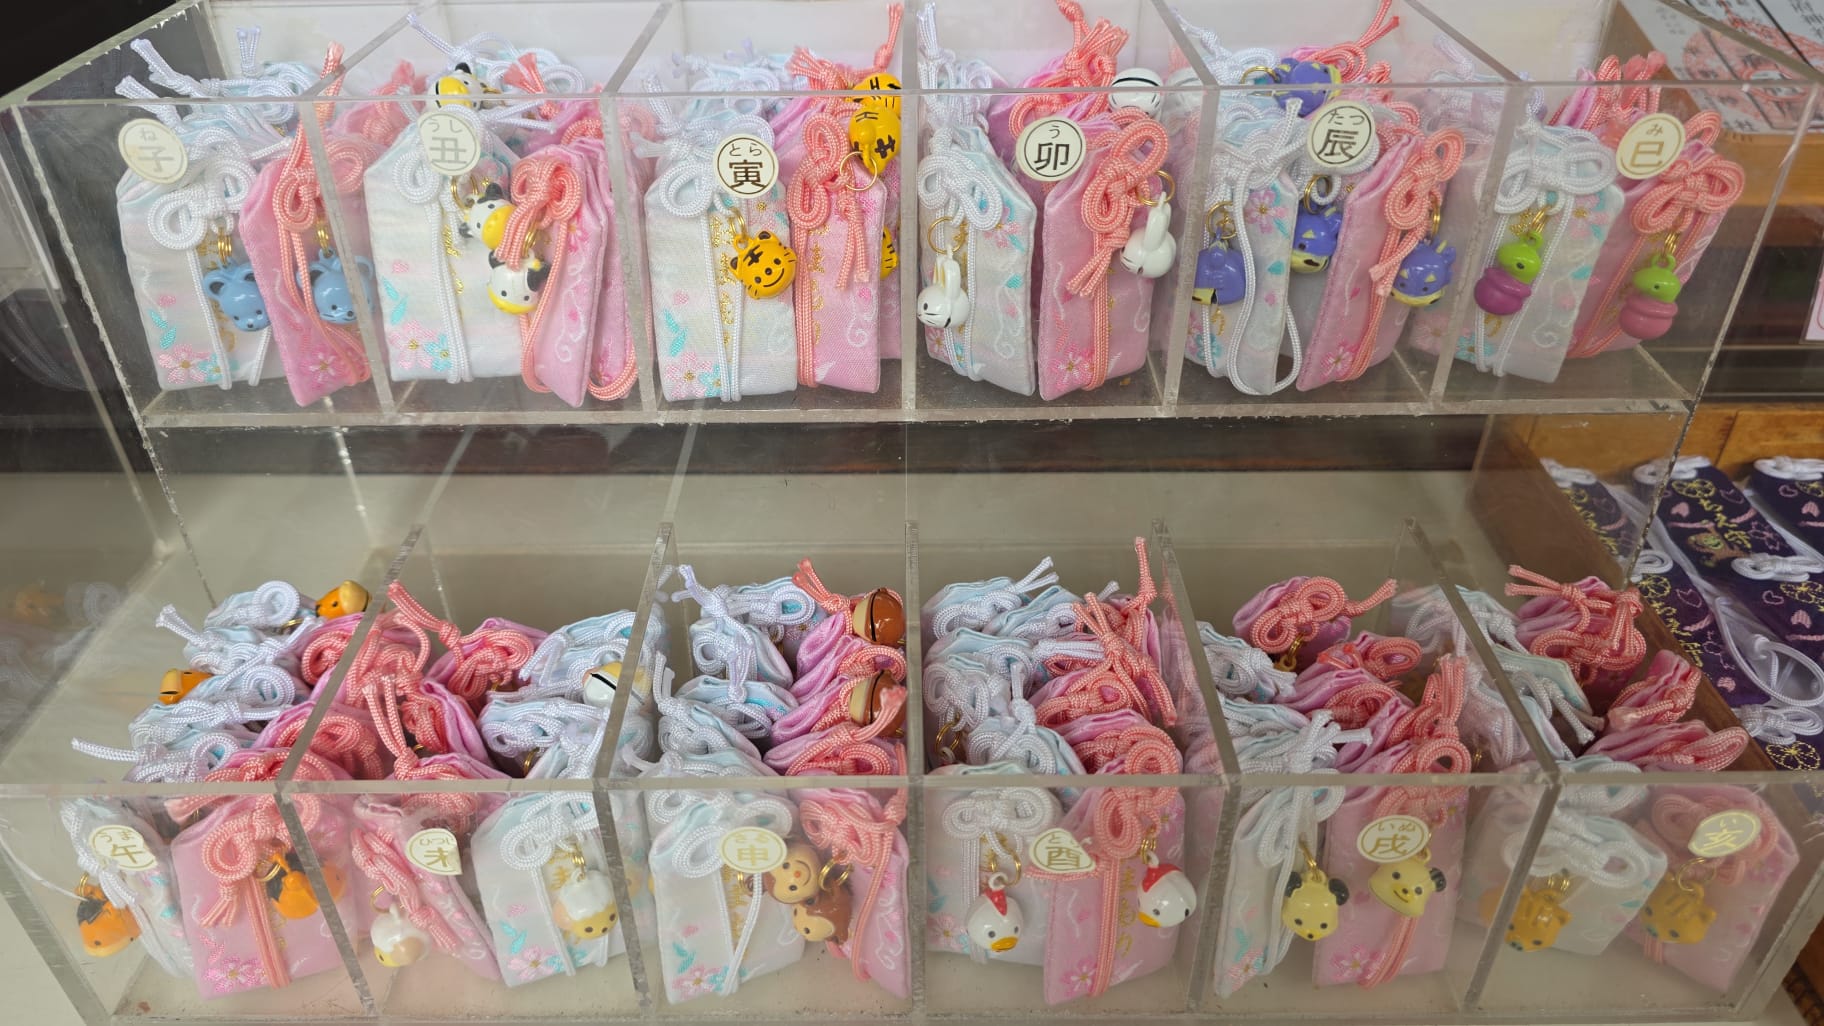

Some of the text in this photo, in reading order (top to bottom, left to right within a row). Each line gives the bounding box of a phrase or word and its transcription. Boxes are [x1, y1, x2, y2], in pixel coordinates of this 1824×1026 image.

[428, 118, 462, 133] うし
[1327, 109, 1365, 126] たつ
[140, 127, 158, 141] ね
[1048, 125, 1060, 138] う
[1646, 124, 1663, 136] み
[429, 136, 467, 165] 丑
[730, 143, 762, 157] とら
[1318, 129, 1360, 158] 辰
[1630, 140, 1665, 167] 巳
[137, 146, 174, 173] 子
[1034, 142, 1070, 171] 卯
[729, 159, 766, 189] 寅
[1377, 822, 1416, 832] いぬ
[1719, 818, 1737, 828] い
[1367, 834, 1411, 855] 戌
[1703, 829, 1744, 850] 亥
[110, 844, 143, 864] 午
[737, 845, 769, 866] 申
[1045, 846, 1082, 868] 酉
